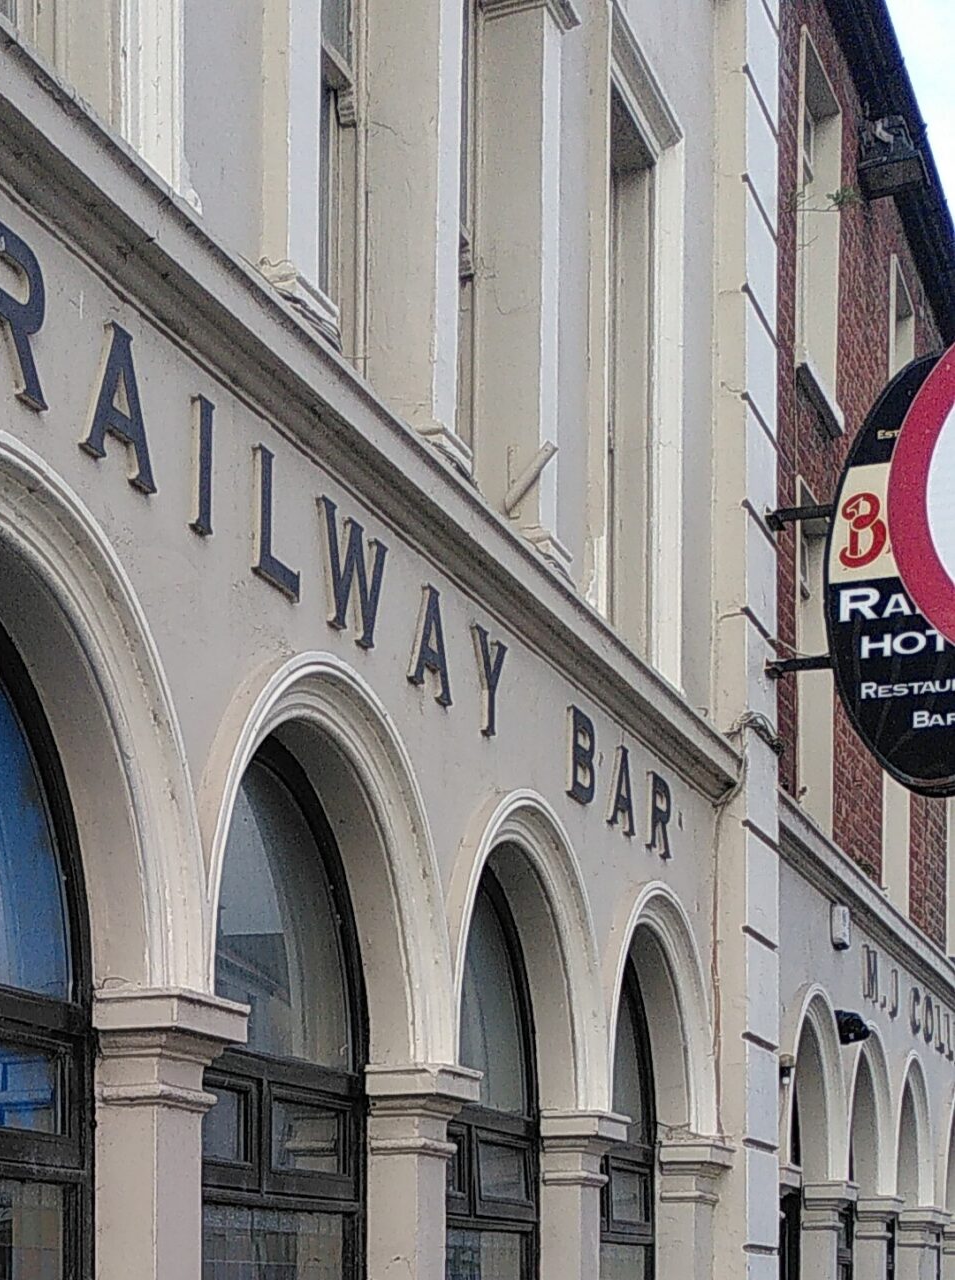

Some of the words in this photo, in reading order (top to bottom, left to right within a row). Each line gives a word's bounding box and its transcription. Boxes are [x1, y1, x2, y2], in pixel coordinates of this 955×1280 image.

[839, 587, 921, 622] RA
[861, 678, 955, 699] RESTAU
[565, 704, 673, 860] BAR
[909, 986, 955, 1062] COLL
